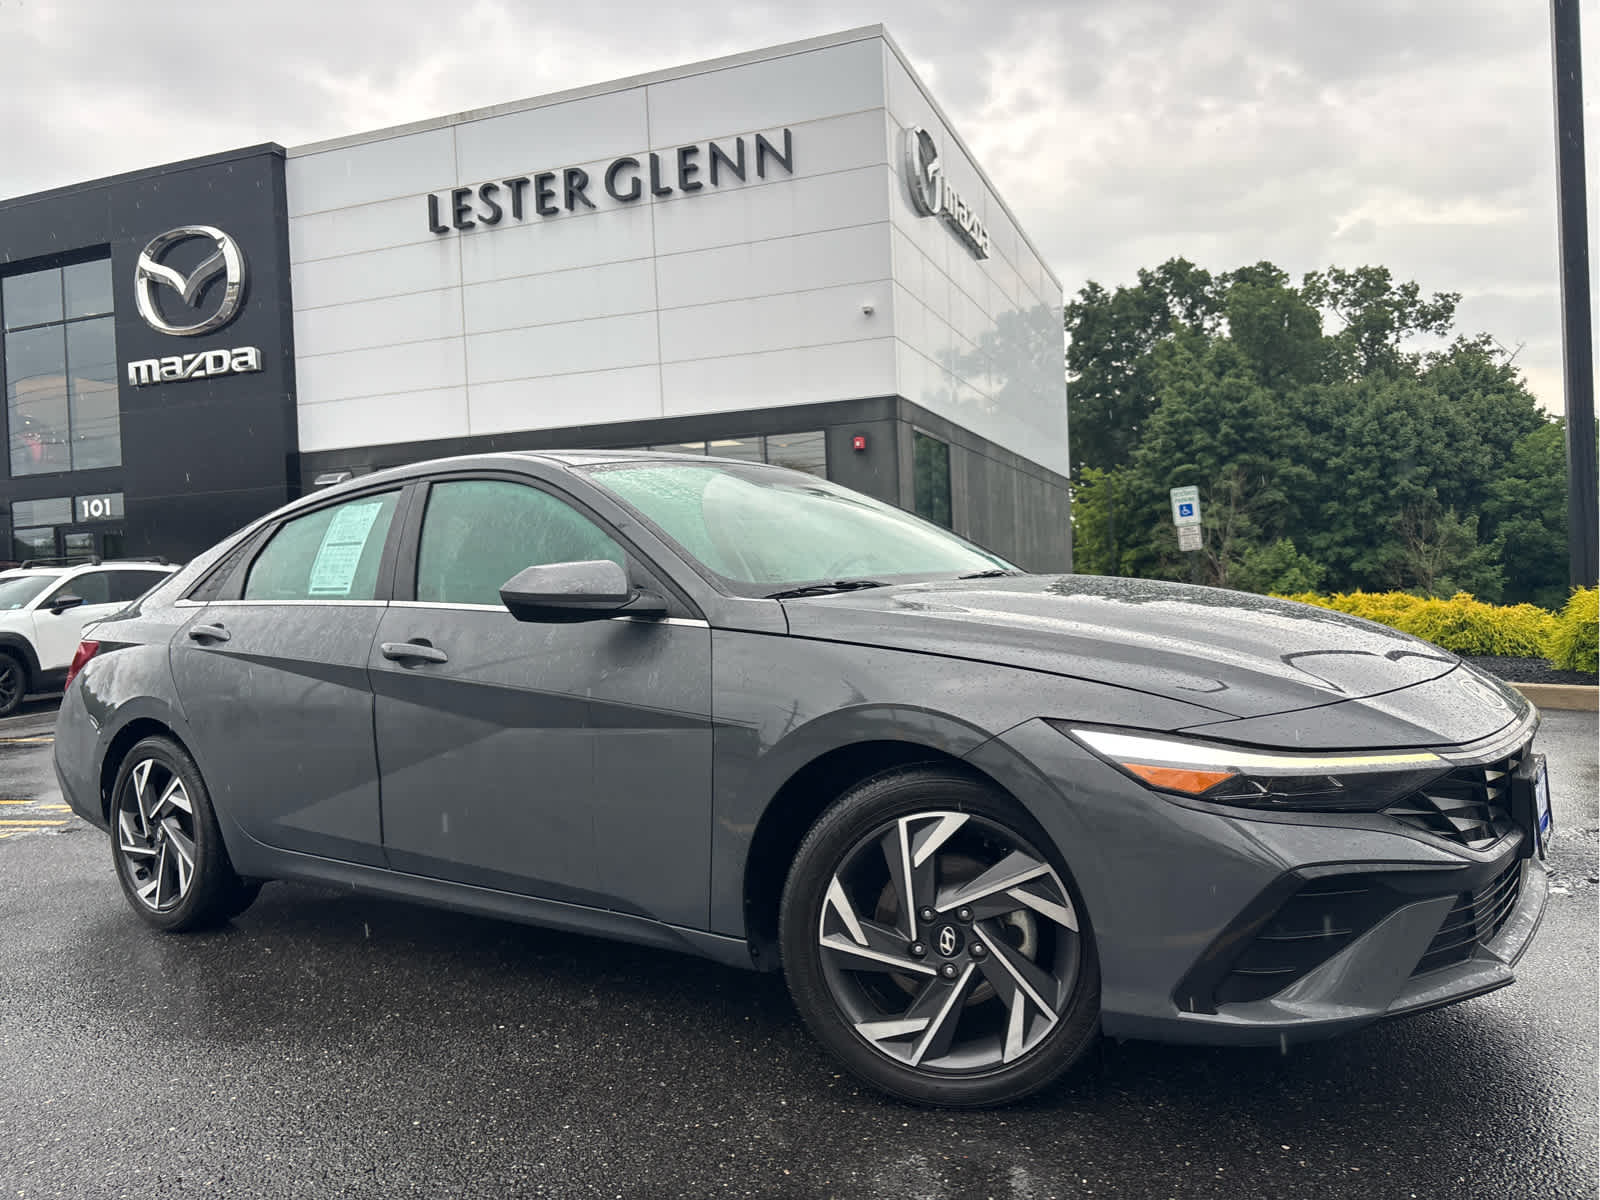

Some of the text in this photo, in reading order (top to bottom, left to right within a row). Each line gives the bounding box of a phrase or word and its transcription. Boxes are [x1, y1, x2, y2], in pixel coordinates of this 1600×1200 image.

[427, 127, 793, 235] LESTER GLENN
[127, 346, 262, 387] mazda
[82, 498, 111, 518] 101
